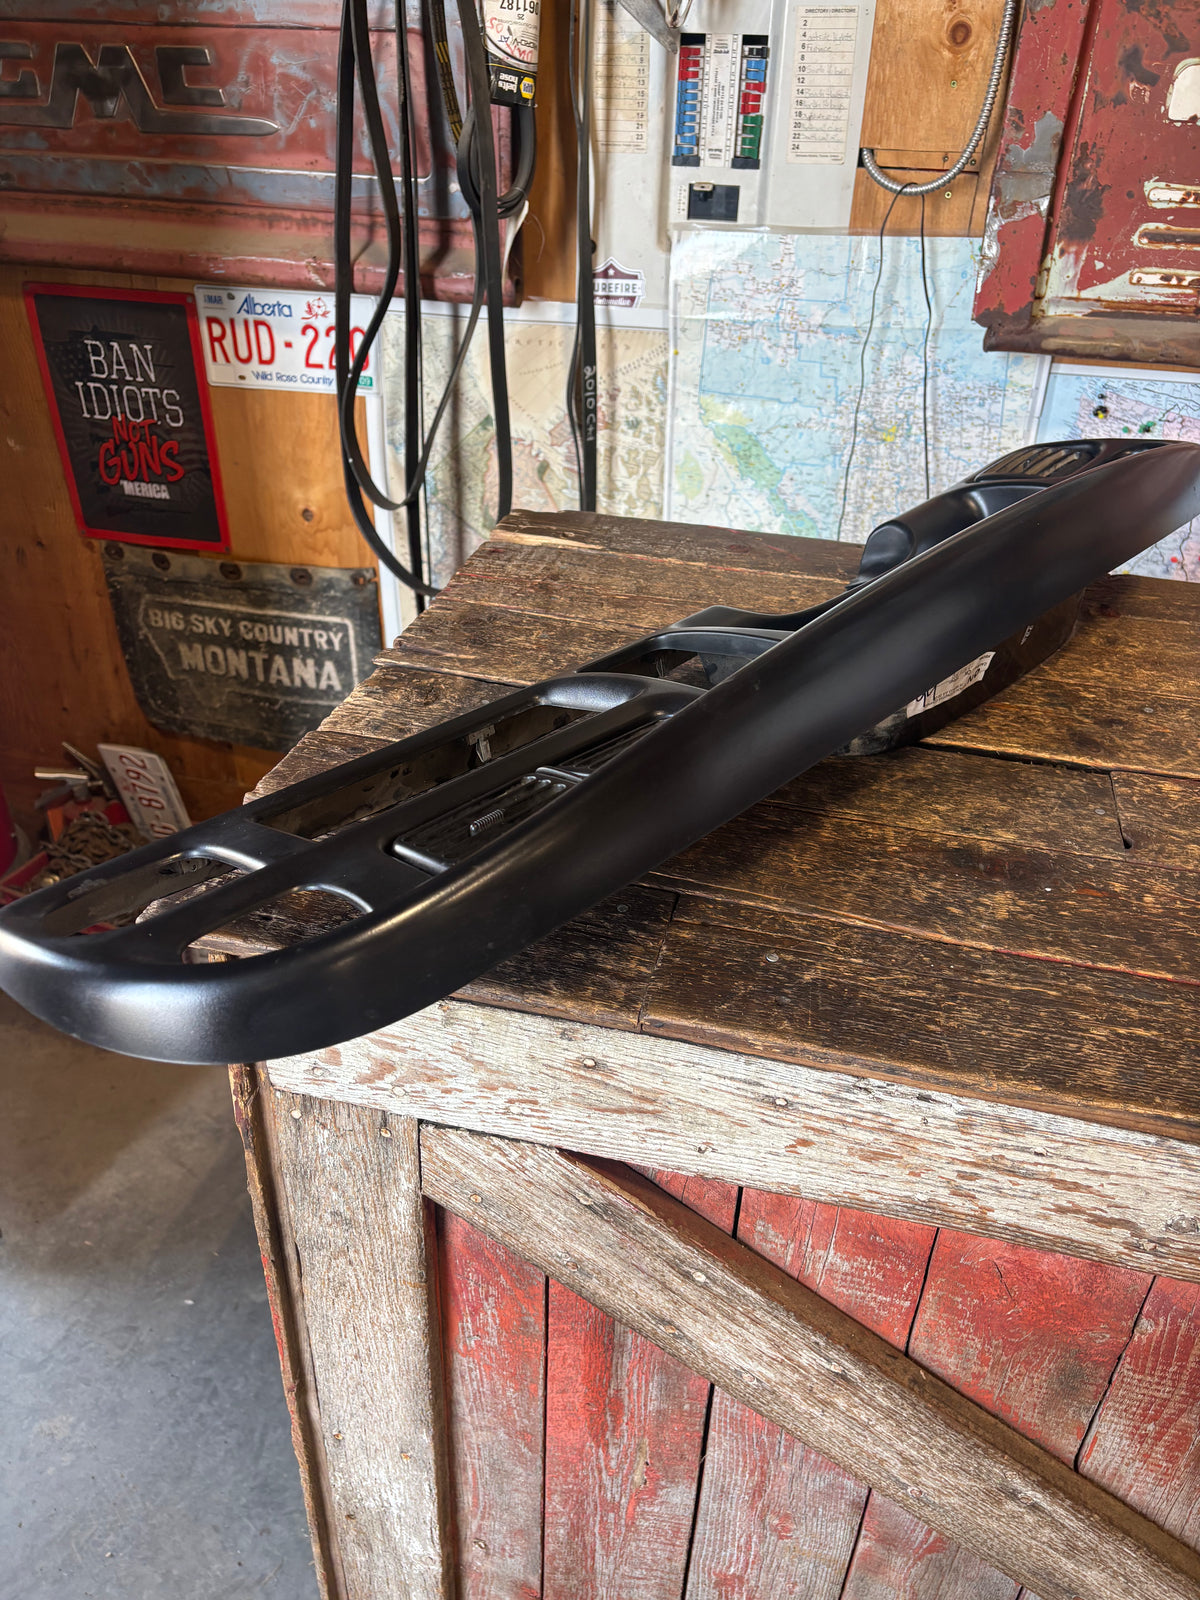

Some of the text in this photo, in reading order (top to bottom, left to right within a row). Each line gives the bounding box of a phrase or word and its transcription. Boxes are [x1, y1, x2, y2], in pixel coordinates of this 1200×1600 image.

[802, 19, 808, 27] 2
[801, 42, 806, 50] 6
[800, 54, 806, 62] 8
[798, 65, 807, 73] 10
[0, 40, 228, 134] GMC
[796, 88, 805, 96] 14
[795, 99, 804, 107] 16
[794, 110, 803, 118] 18
[793, 121, 802, 129] 20
[791, 143, 800, 151] 24
[236, 293, 293, 318] Alberta
[84, 339, 156, 383] BAN
[251, 370, 335, 387] Wild Rose Country
[583, 365, 596, 409] 2010
[75, 381, 185, 428] IDIOTS
[111, 413, 157, 446] NOT
[98, 434, 185, 486] GUNS
[119, 479, 171, 500] 'MERICA
[150, 608, 344, 652] BIG SKY COUNTRY
[177, 642, 343, 692] MONTANA
